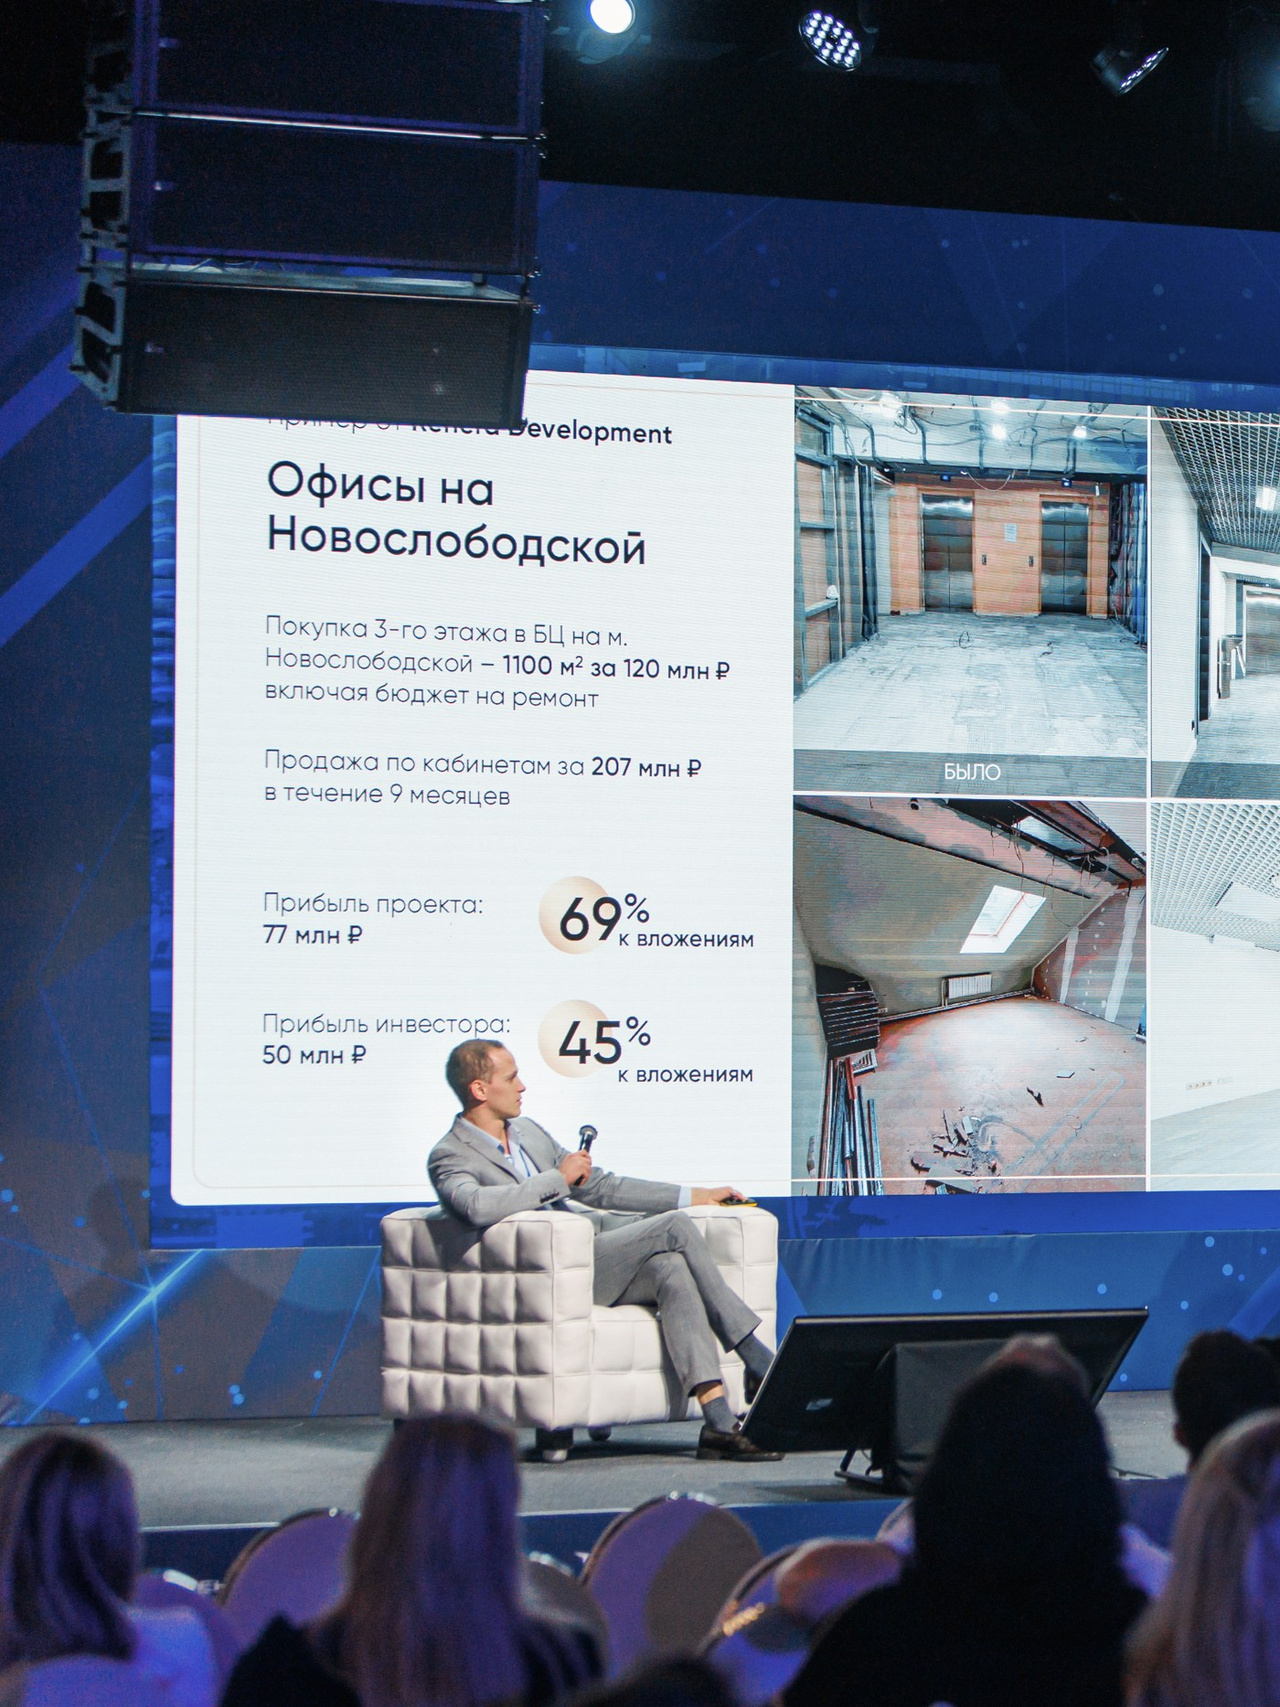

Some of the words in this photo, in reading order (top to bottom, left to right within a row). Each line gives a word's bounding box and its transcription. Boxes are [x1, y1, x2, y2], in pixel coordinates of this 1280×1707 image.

[268, 461, 424, 508] Офисы
[442, 479, 492, 505] на
[269, 515, 644, 567] Новослободской
[267, 615, 367, 641] Покупка
[375, 619, 426, 639] 3-го
[435, 626, 506, 642] этажа
[515, 629, 525, 642] в
[535, 624, 564, 647] БЦ
[573, 631, 599, 645] на
[609, 632, 627, 646] м.
[267, 647, 471, 674] Новослободской
[503, 655, 552, 675] 1100
[591, 663, 615, 677] за
[624, 659, 659, 678] 120
[668, 665, 708, 679] млн
[266, 685, 367, 701] включая
[376, 683, 469, 706] бюджет
[477, 691, 504, 705] на
[513, 692, 599, 710] ремонт
[266, 749, 378, 773] Продажа
[388, 757, 415, 771] по
[424, 754, 550, 774] кабинетам
[558, 761, 583, 775] за
[592, 757, 631, 776] 207
[640, 763, 679, 777] млн
[945, 763, 1001, 781] БЫЛО
[266, 787, 276, 800] в
[284, 787, 382, 803] течение
[390, 784, 402, 802] 9
[411, 790, 510, 808] месяцев
[265, 892, 369, 916] Прибыль
[378, 899, 482, 917] проекта:
[559, 892, 651, 942] 69%
[263, 925, 287, 943] 77
[296, 930, 339, 944] млн
[618, 934, 630, 947] к
[638, 934, 753, 947] вложениям
[264, 1014, 368, 1036] Прибыль
[377, 1019, 509, 1040] инвестора:
[558, 1016, 651, 1065] 45%
[263, 1045, 290, 1064] 50
[301, 1051, 343, 1063] млн
[619, 1070, 628, 1082] к
[637, 1069, 752, 1082] вложениям
